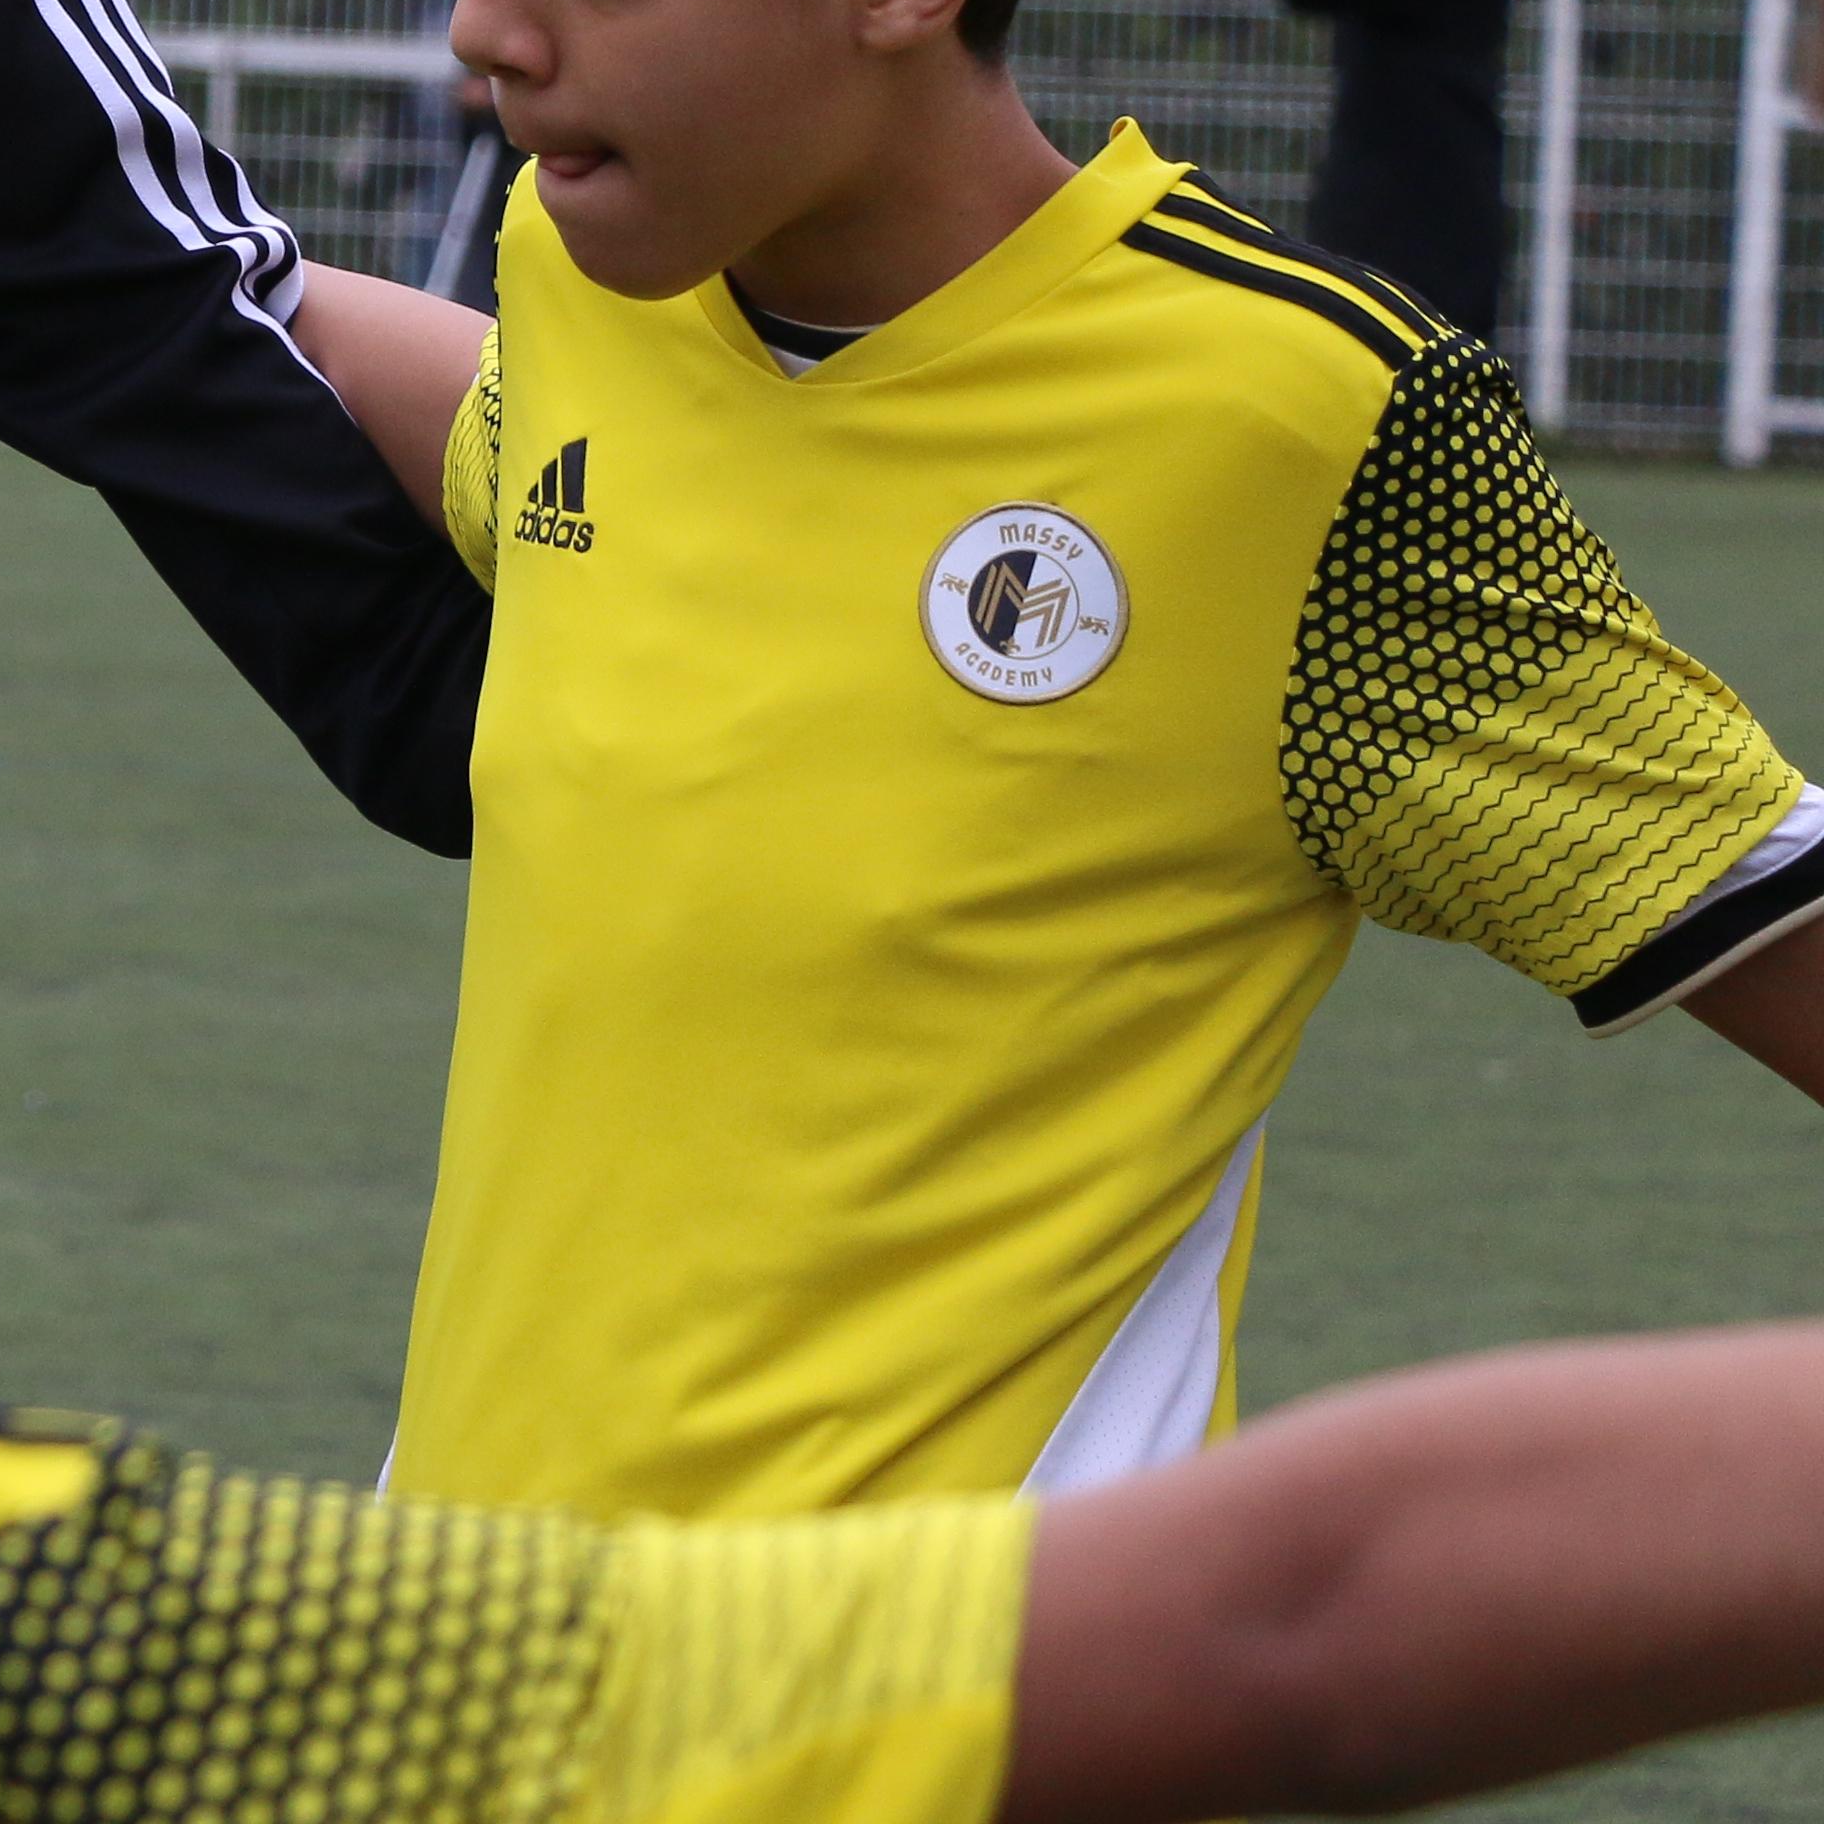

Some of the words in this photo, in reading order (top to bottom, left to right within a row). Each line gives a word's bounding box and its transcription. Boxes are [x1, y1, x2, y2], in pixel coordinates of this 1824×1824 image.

[514, 504, 594, 553] adidas
[999, 523, 1084, 561] MASSY
[955, 642, 1053, 687] ACADEMY
